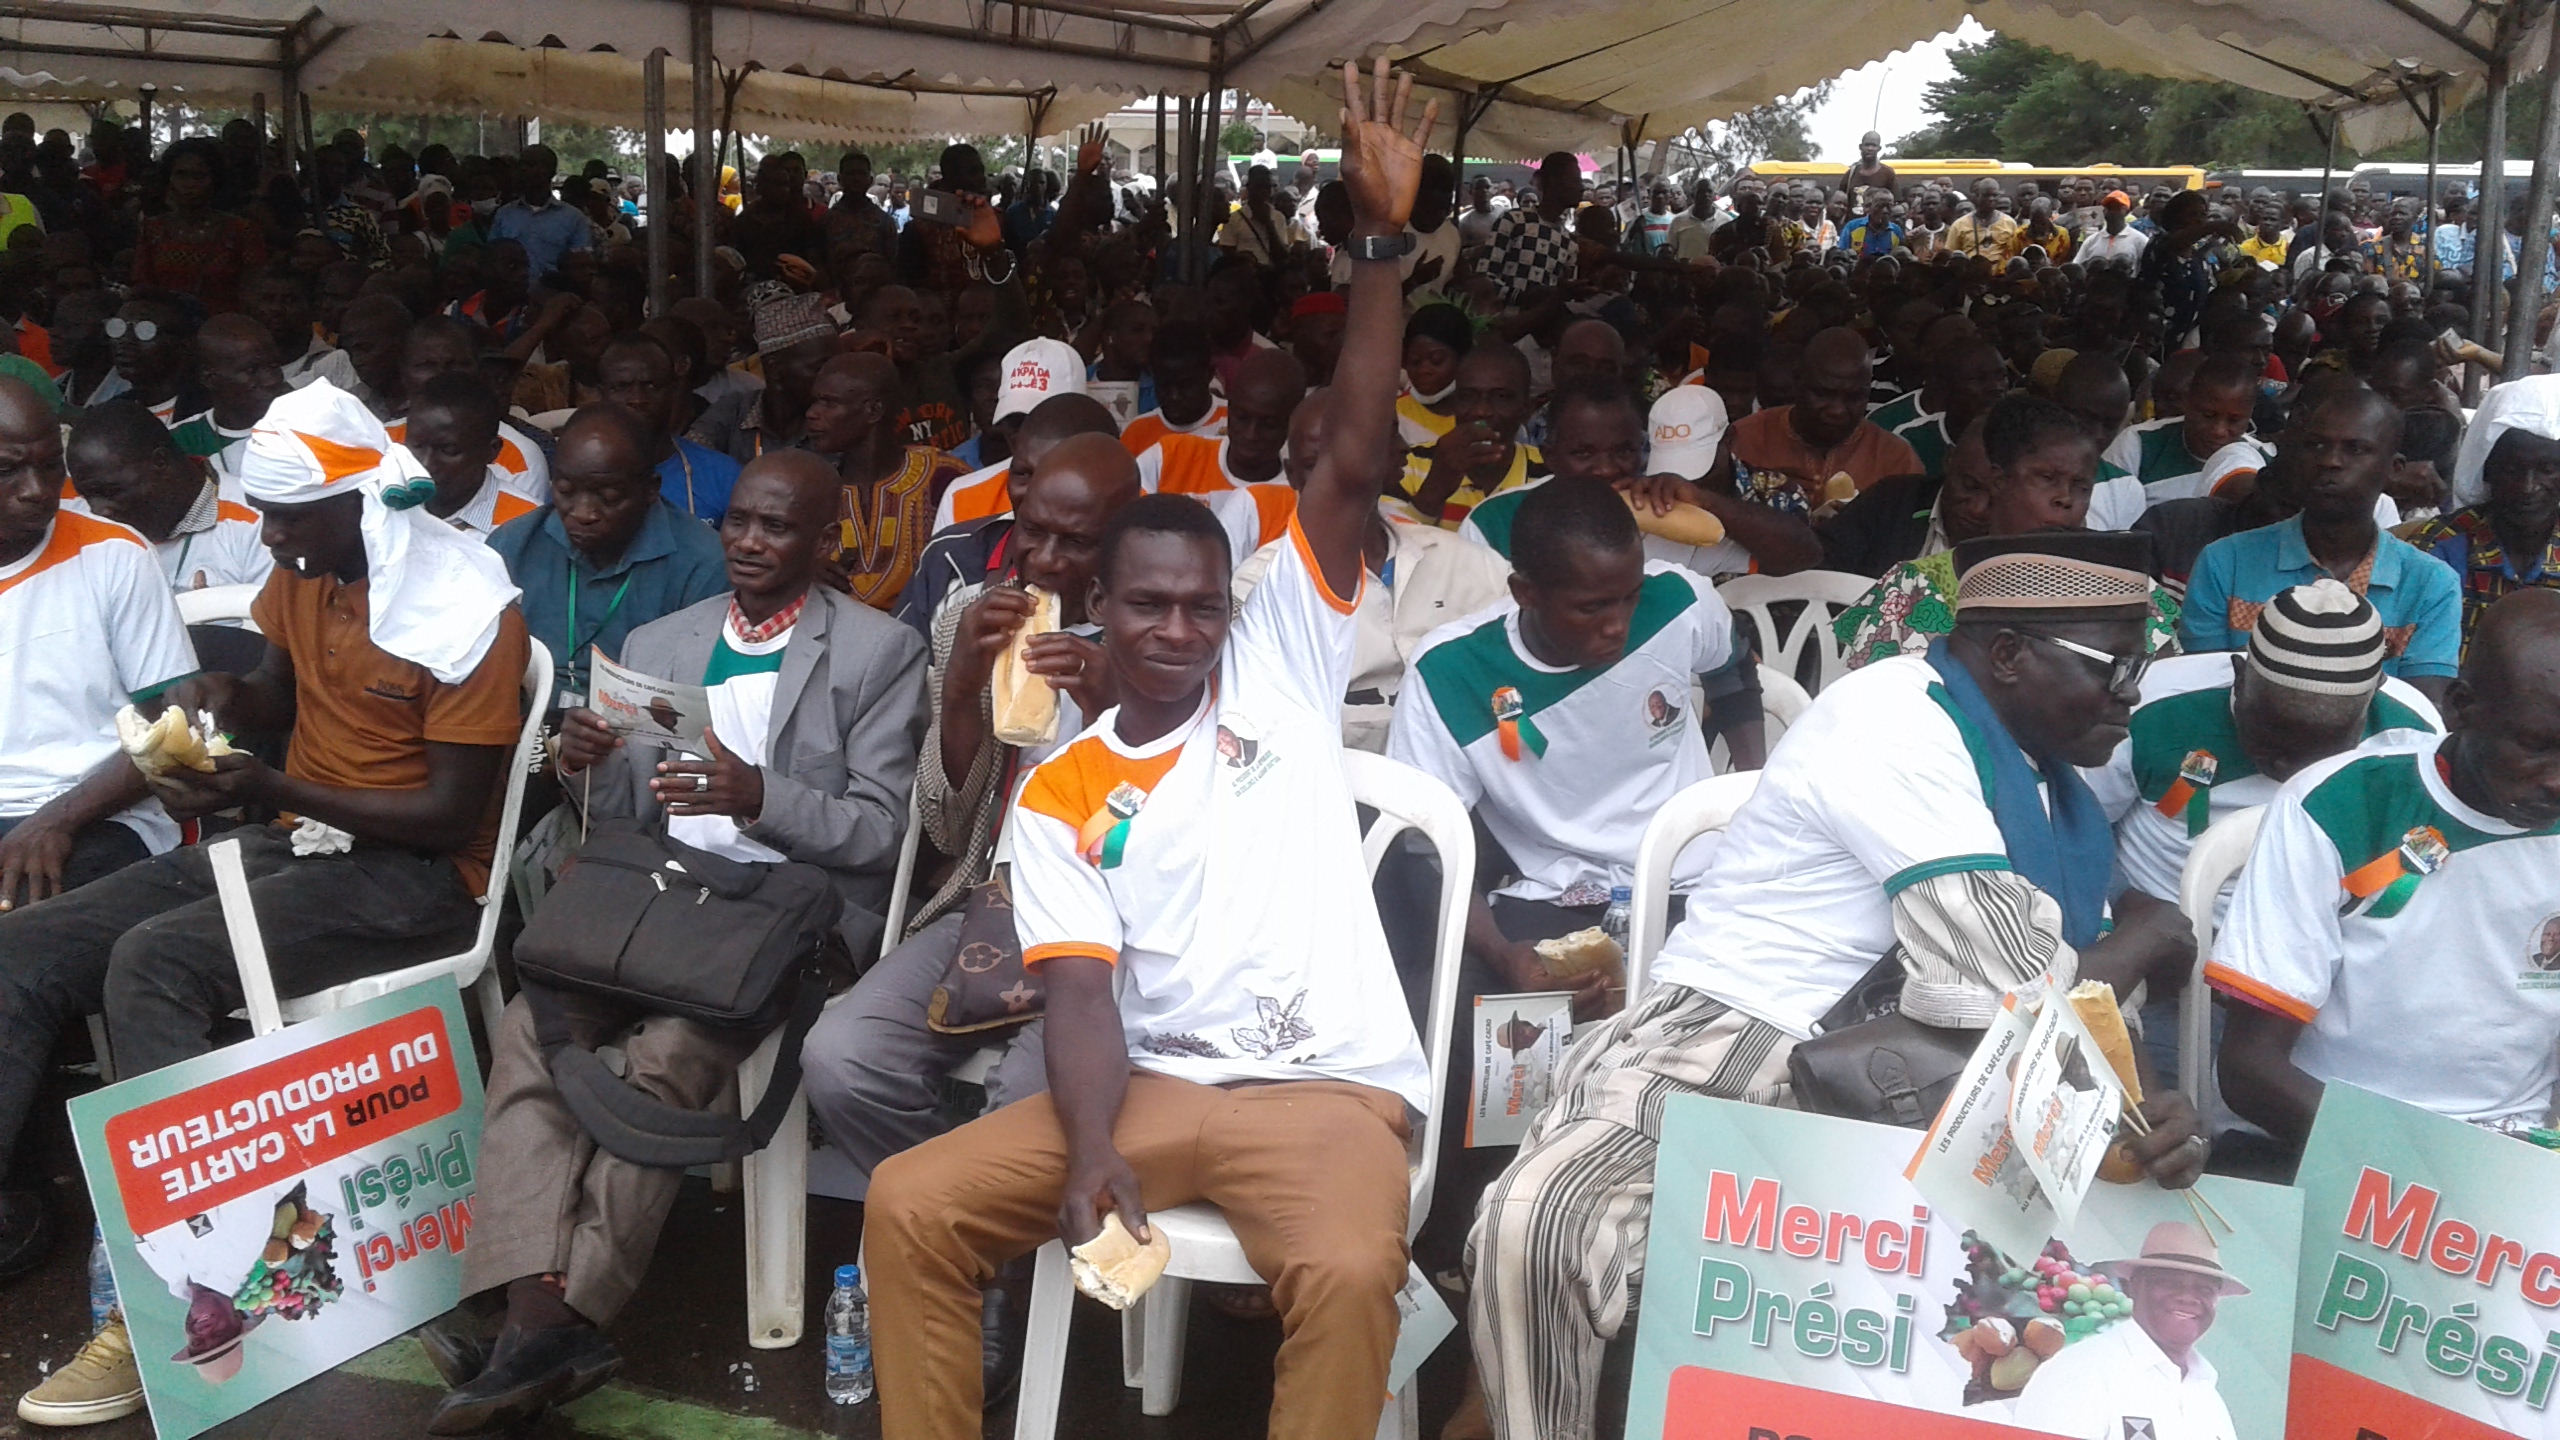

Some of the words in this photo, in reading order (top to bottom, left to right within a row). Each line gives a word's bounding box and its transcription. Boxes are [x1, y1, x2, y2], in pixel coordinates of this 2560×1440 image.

[909, 420, 932, 441] NY
[1654, 424, 1691, 439] ADO
[389, 1032, 439, 1073] DU
[1505, 1064, 1526, 1117] Merci
[1937, 1134, 1951, 1154] LES
[1948, 1085, 1982, 1139] PRODUCTEURS
[1978, 1073, 1989, 1087] DE
[1985, 1029, 2015, 1076] CAFÉ-CACAO
[128, 1053, 382, 1169] PRODUCTEUR
[292, 1110, 336, 1147] LA
[345, 1075, 430, 1127] POUR
[2033, 1091, 2063, 1163] Merci
[160, 1130, 286, 1202] CARTE
[342, 1131, 473, 1232] Prési
[354, 1194, 475, 1293] Merci
[1702, 1168, 1929, 1278] Merci
[2342, 1164, 2560, 1308] Merc
[1692, 1255, 1914, 1373] Prési
[2313, 1249, 2560, 1409] Prési
